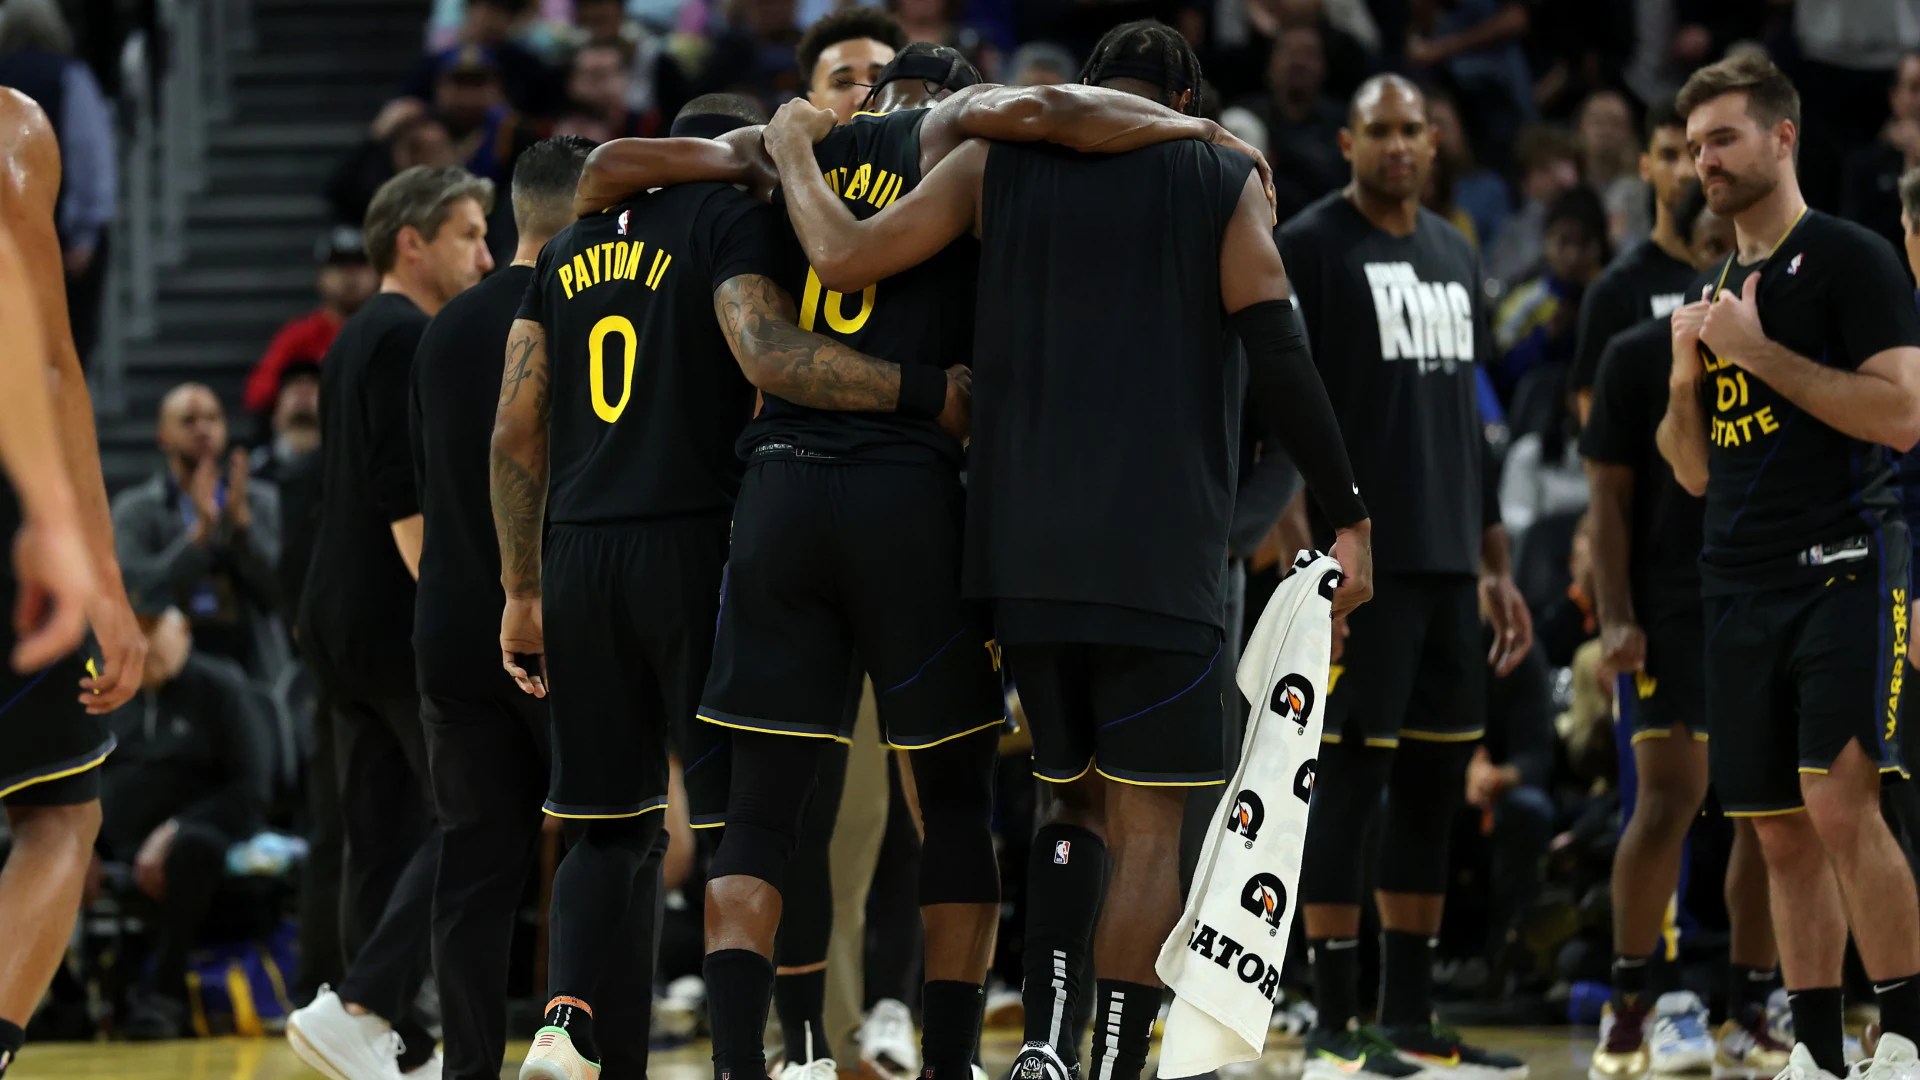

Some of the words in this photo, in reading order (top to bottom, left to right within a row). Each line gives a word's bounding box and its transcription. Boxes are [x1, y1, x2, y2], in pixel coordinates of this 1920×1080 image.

[867, 169, 903, 209] III
[558, 241, 645, 300] PAYTON
[645, 248, 672, 291] II
[1372, 281, 1474, 361] KING
[588, 315, 637, 423] 0
[1885, 588, 1907, 740] WARRIORS
[1187, 919, 1279, 1004] ATOR
